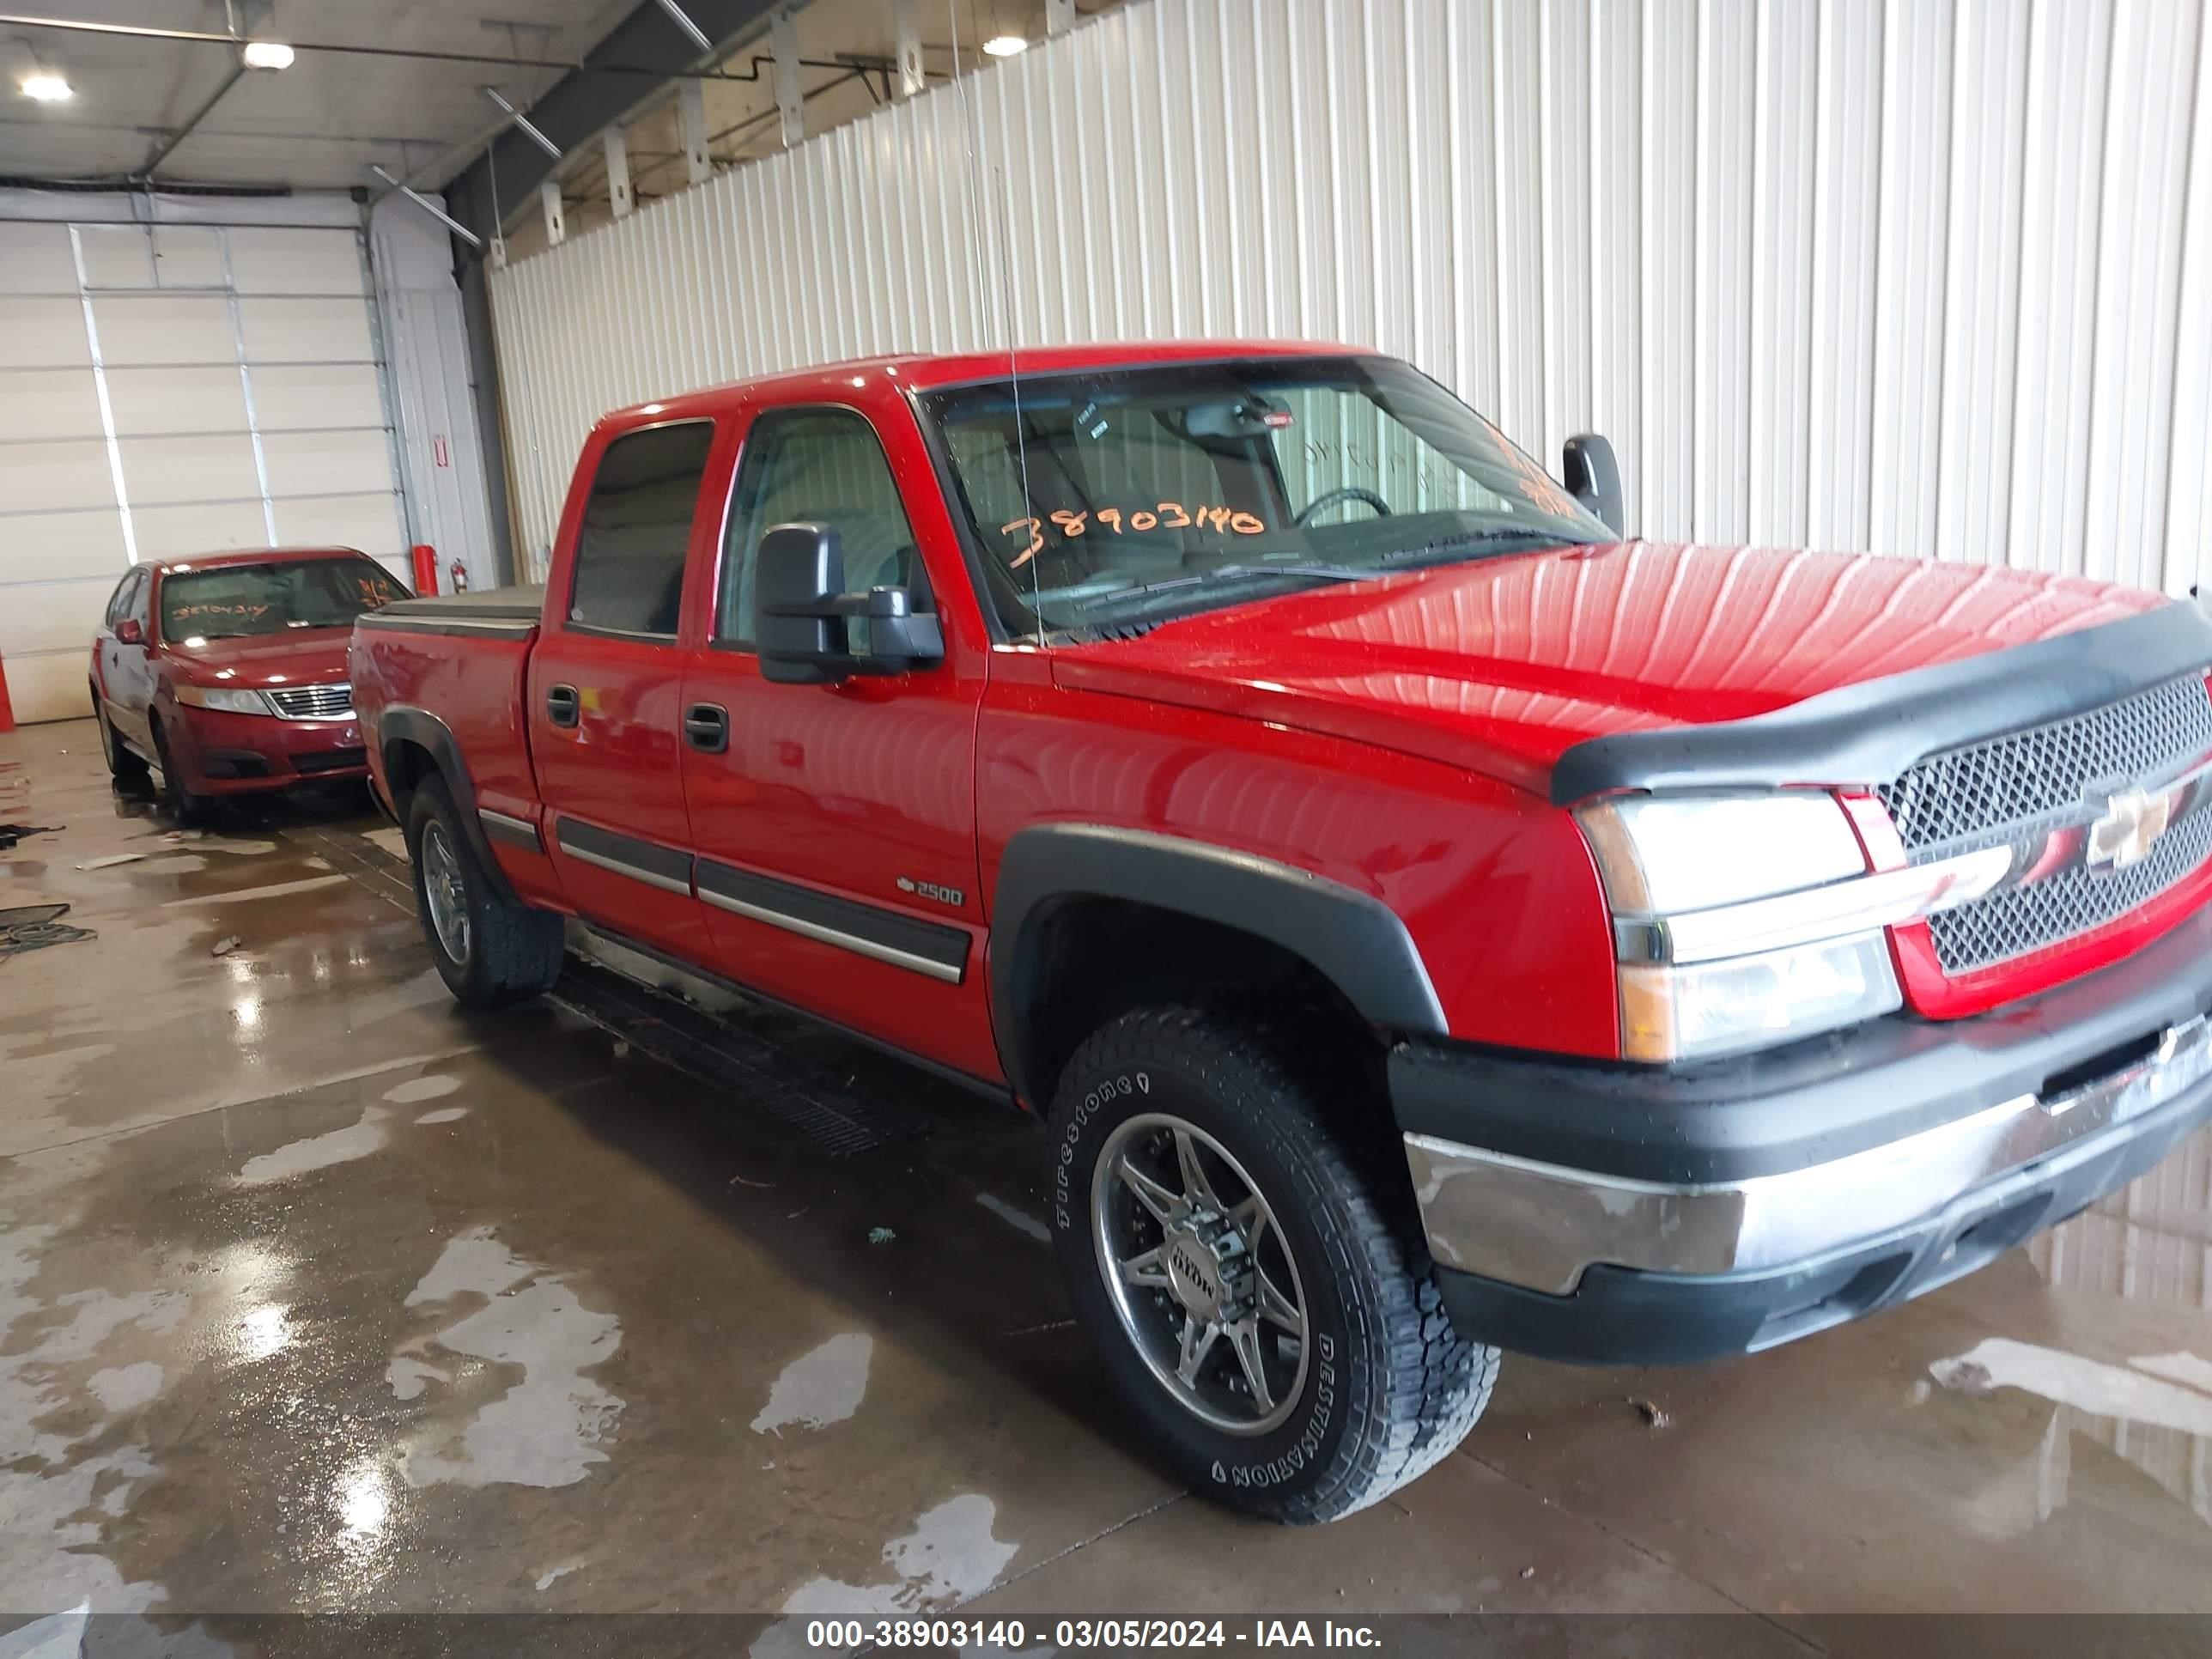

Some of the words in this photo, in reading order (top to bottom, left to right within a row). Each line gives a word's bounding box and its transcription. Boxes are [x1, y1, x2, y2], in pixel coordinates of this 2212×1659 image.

[1001, 503, 1264, 568] 38903140
[917, 881, 963, 907] 2500
[1231, 1332, 1335, 1487] DESTINATION
